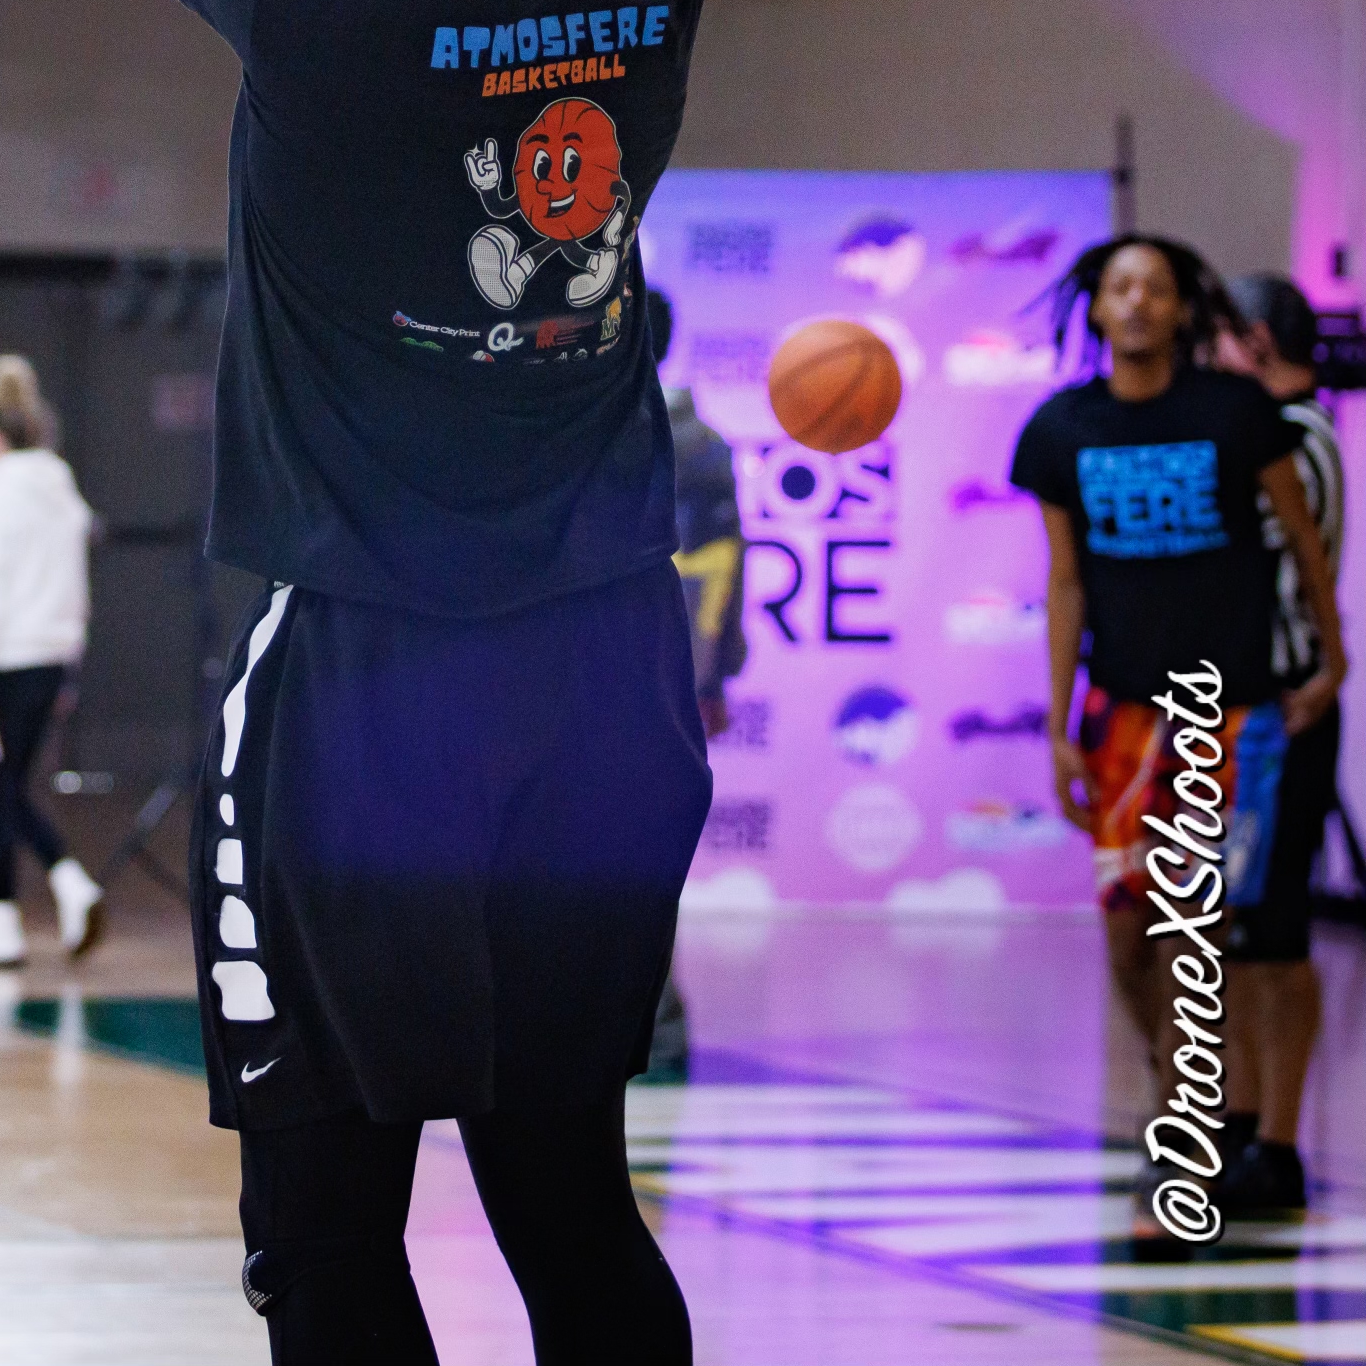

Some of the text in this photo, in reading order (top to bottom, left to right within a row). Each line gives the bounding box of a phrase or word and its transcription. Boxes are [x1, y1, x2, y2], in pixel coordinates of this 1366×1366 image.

[430, 5, 670, 68] ATMOSFERE
[481, 54, 626, 97] BASKETBALL
[409, 321, 481, 337] Center City Print
[740, 442, 892, 520] OS
[1080, 478, 1224, 532] FERE
